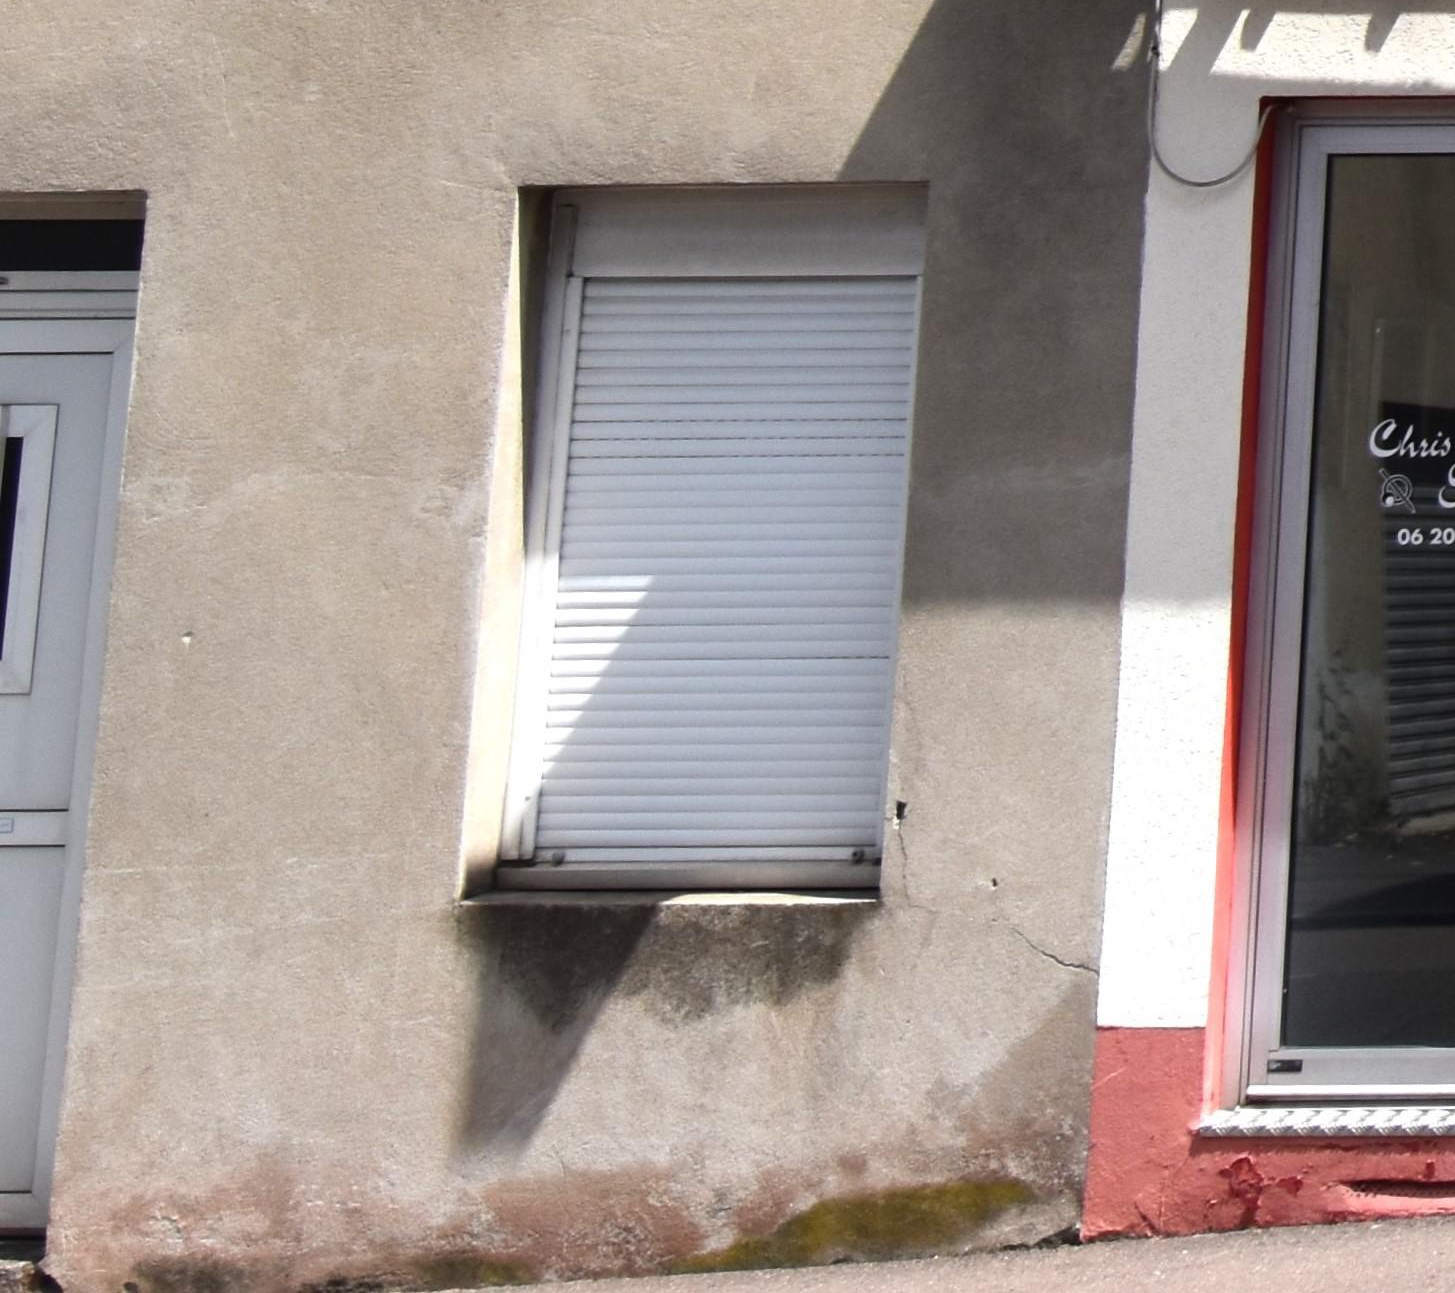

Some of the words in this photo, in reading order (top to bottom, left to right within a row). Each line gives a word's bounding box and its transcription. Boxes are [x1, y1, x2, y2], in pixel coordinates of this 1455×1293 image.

[1370, 419, 1451, 457] Chris
[1397, 527, 1423, 544] 06
[1430, 527, 1455, 544] 20
